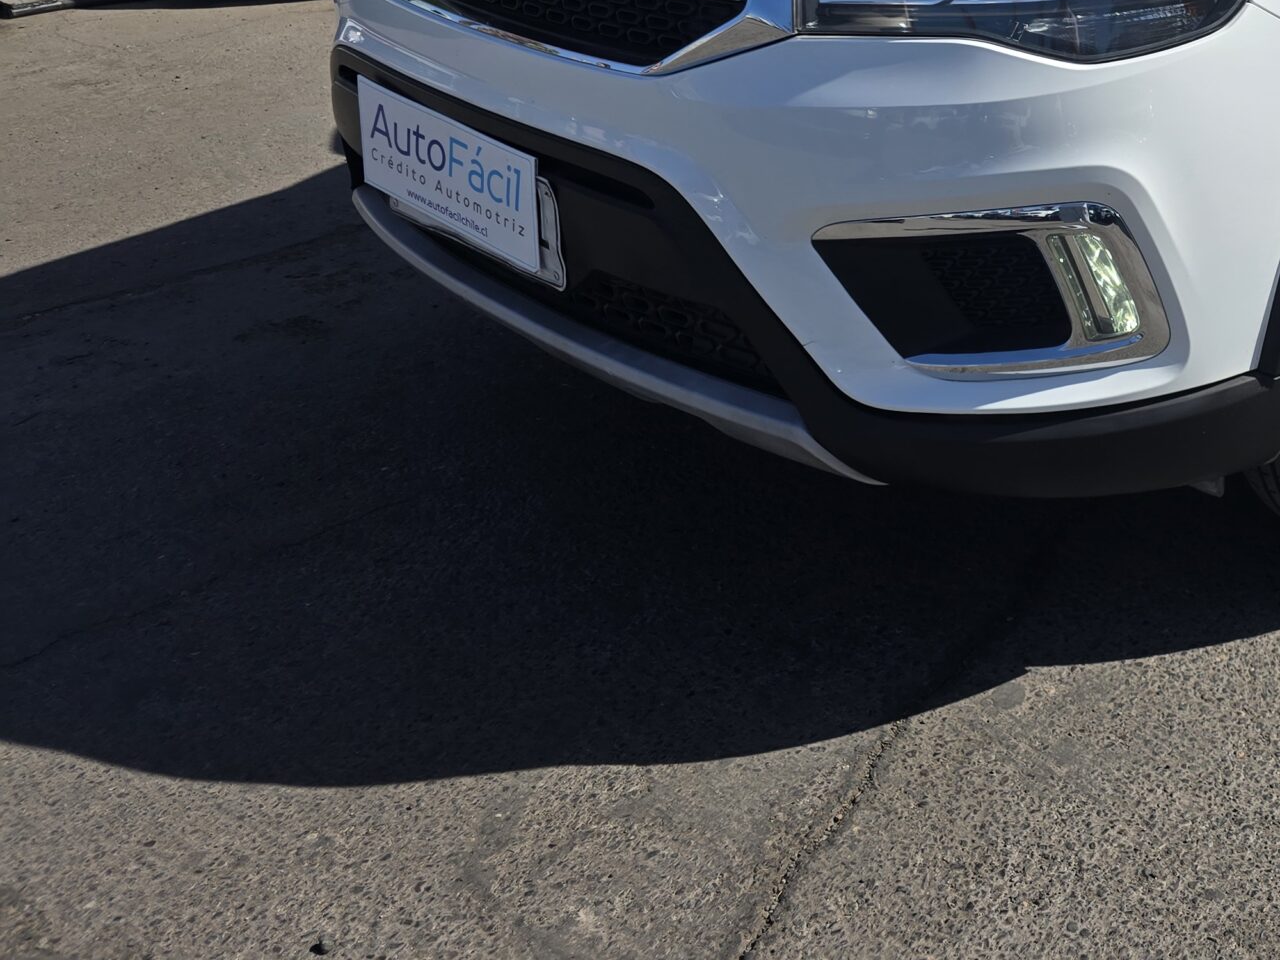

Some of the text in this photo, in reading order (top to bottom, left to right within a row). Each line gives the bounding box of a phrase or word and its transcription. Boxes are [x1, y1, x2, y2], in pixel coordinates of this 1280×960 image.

[370, 103, 521, 212] AutoFácil
[371, 147, 526, 237] Crédito Automotriz
[406, 189, 489, 238] www.autofacilchile.cl
